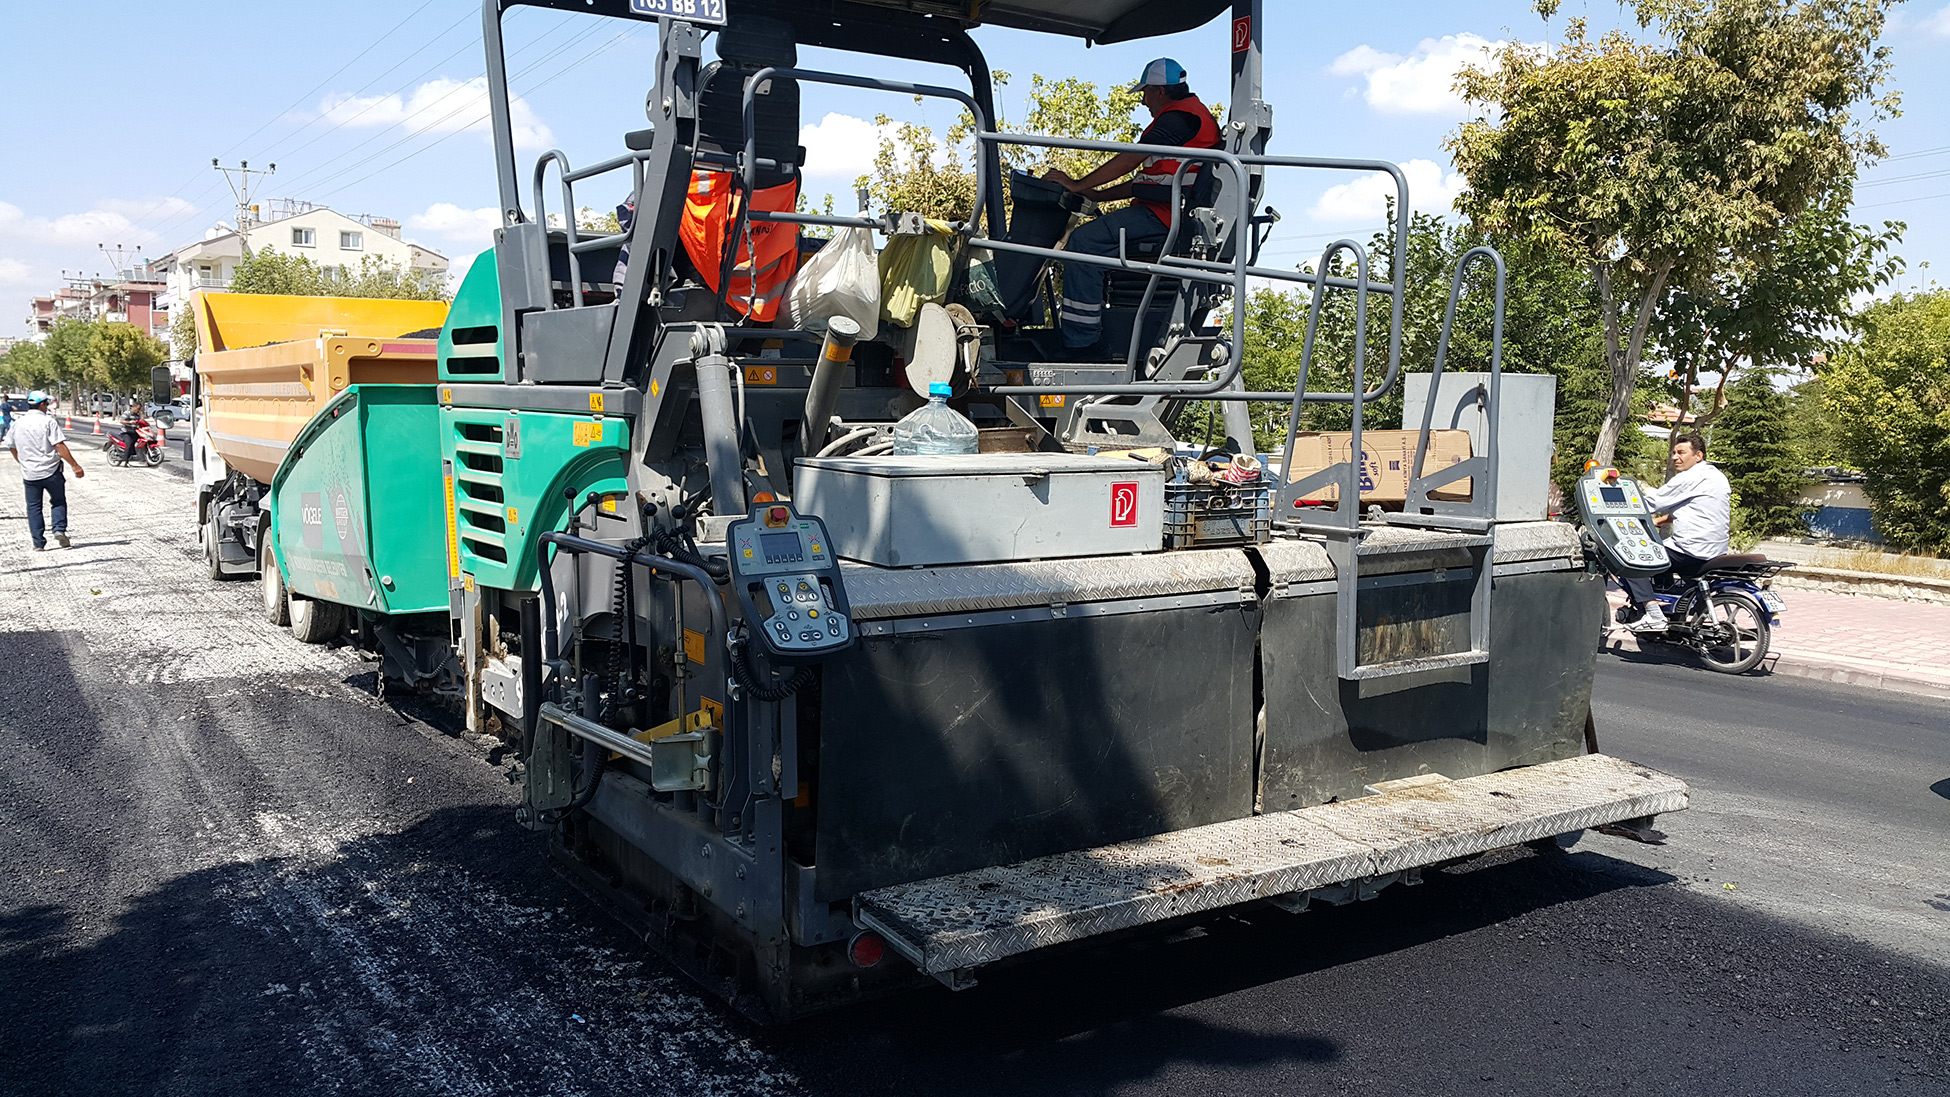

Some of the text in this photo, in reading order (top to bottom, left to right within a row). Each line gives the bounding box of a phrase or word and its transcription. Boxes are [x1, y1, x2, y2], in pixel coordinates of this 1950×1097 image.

[672, 0, 696, 14] BB
[700, 0, 722, 18] 12
[1369, 461, 1378, 476] soft
[302, 504, 322, 525] VÖGELE
